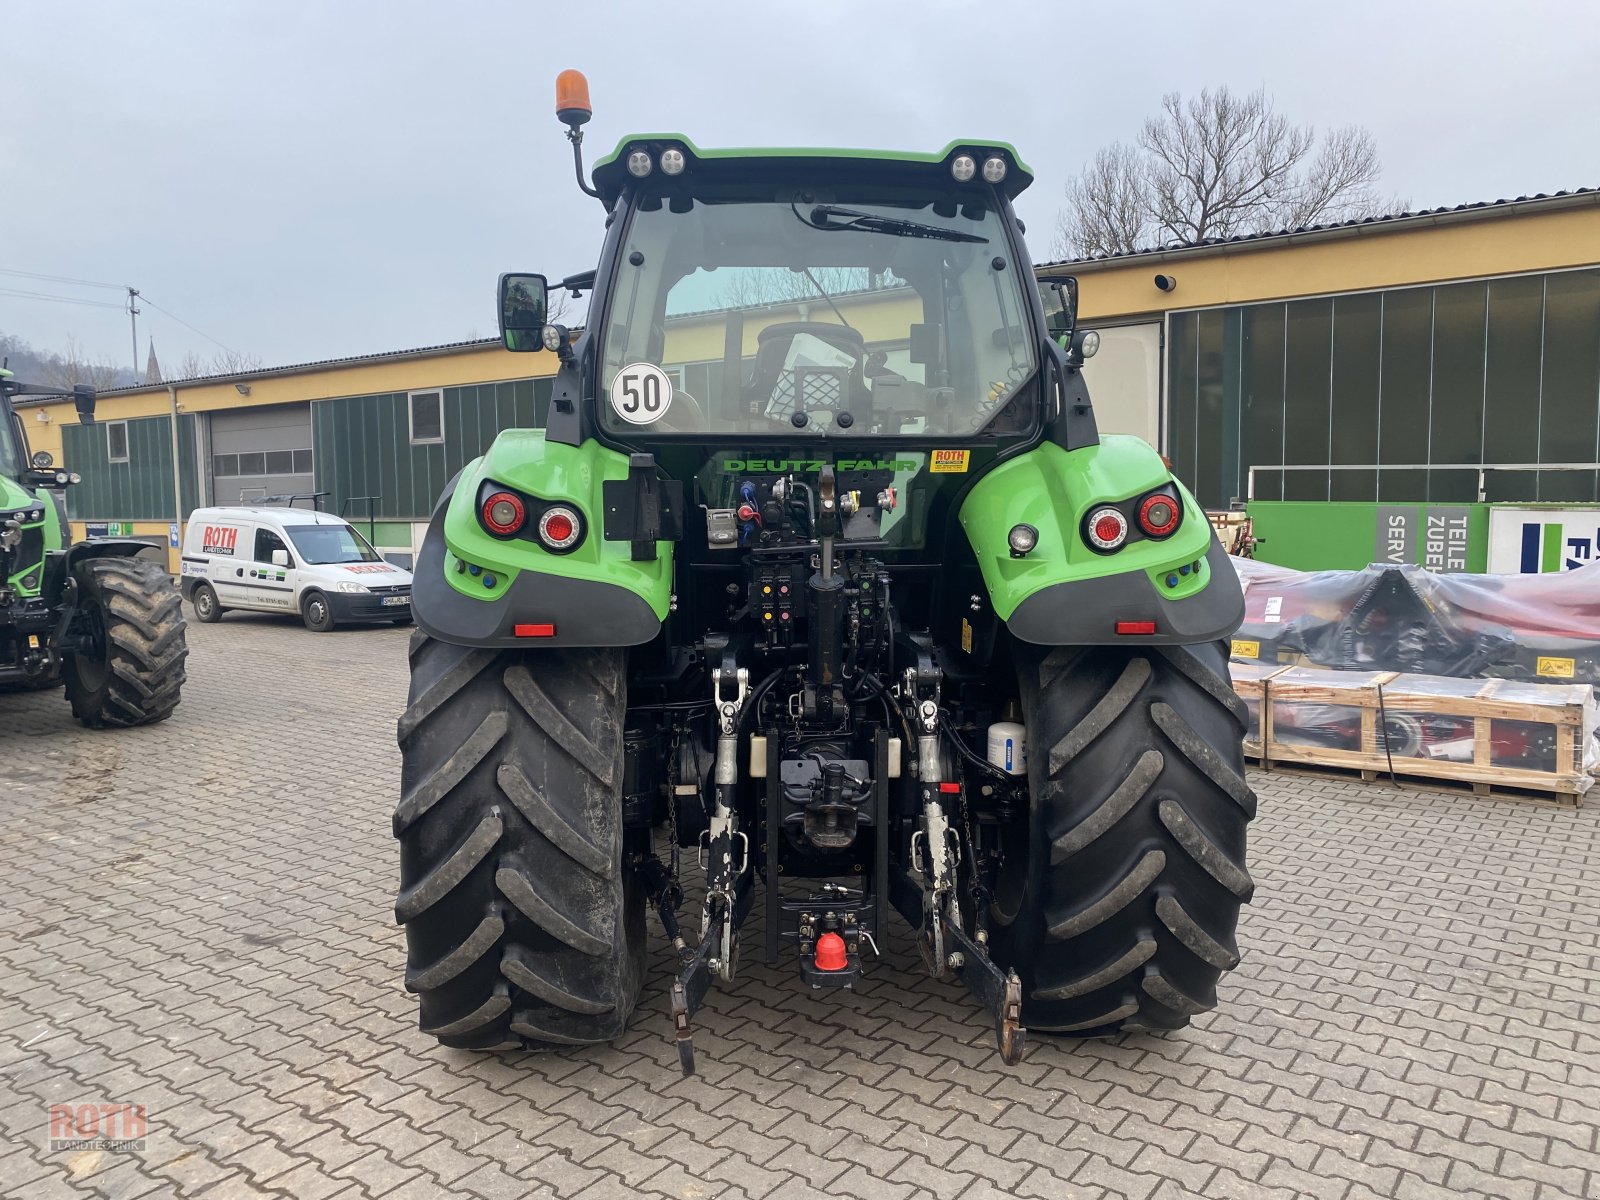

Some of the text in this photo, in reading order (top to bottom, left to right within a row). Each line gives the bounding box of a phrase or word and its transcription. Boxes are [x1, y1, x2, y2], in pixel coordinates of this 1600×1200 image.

[623, 374, 660, 413] 50
[724, 460, 916, 472] DEUTZ-FAHR
[936, 451, 965, 460] ROTH
[203, 526, 237, 548] ROTH
[1388, 515, 1405, 563] SERV
[1447, 516, 1467, 569] TEILE
[204, 545, 233, 555] LANDTECHNIK
